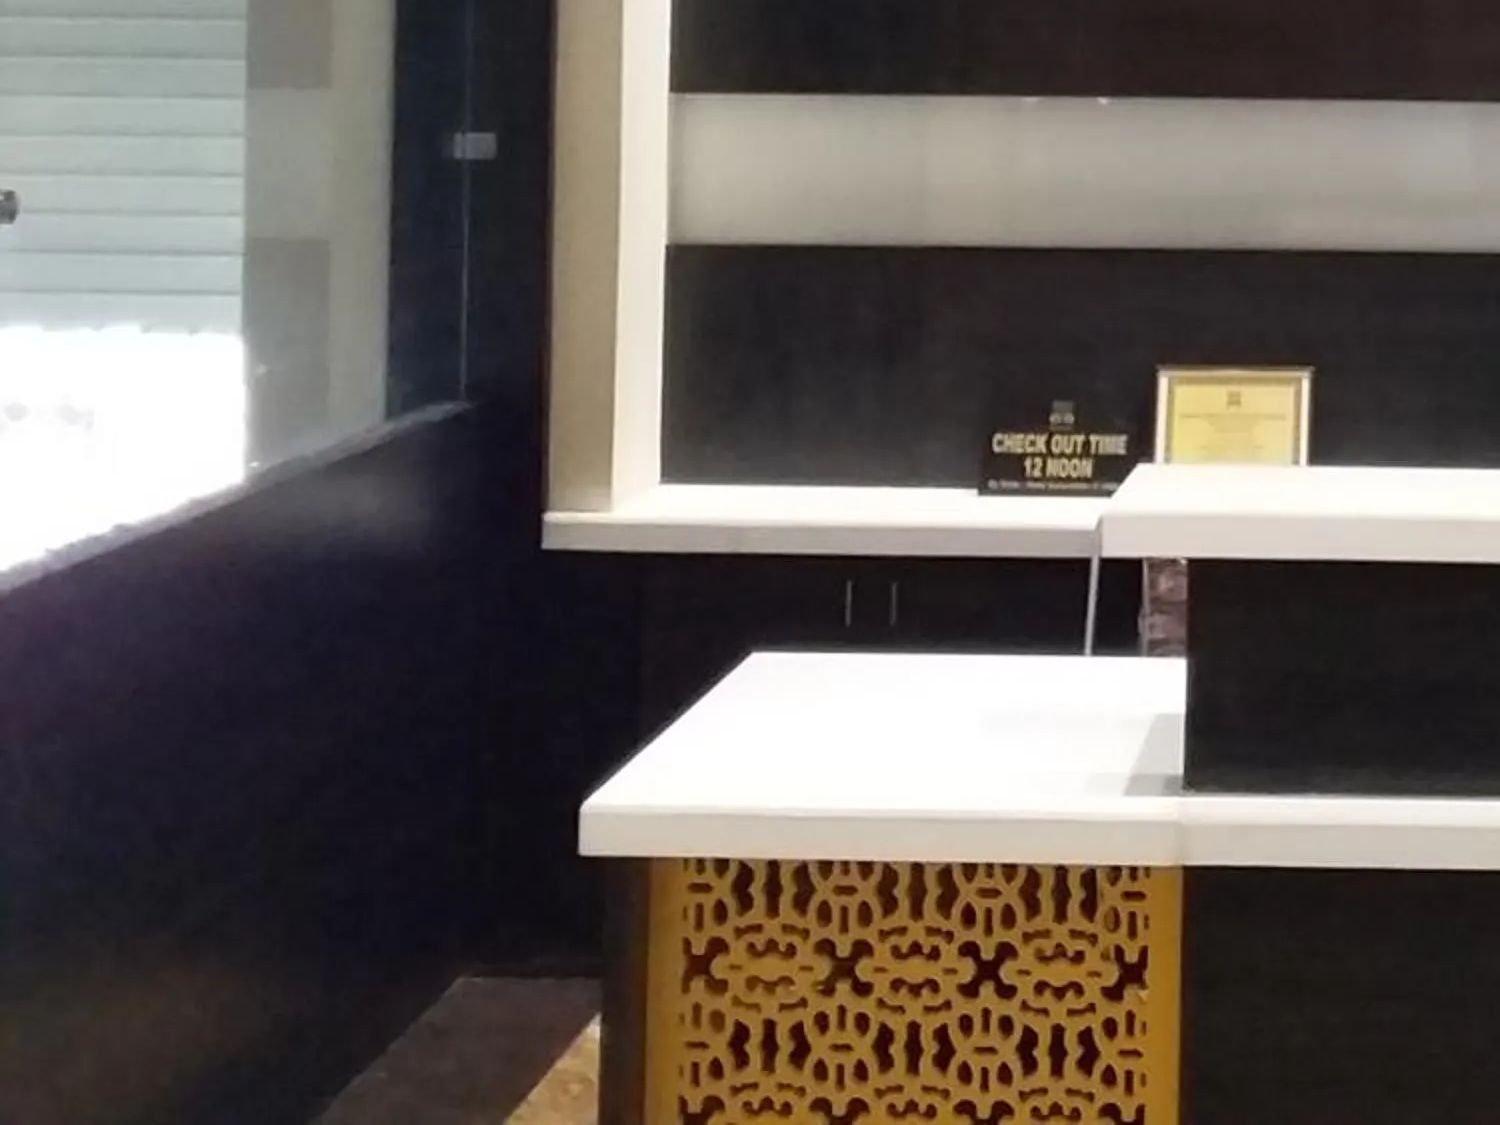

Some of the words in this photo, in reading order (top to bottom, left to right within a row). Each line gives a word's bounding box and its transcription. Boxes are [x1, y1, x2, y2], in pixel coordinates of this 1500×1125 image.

[992, 432, 1048, 454] CHECK
[1051, 434, 1085, 455] OUT
[1088, 434, 1128, 455] TIME
[1024, 457, 1043, 478] 12
[1046, 458, 1093, 478] NOON
